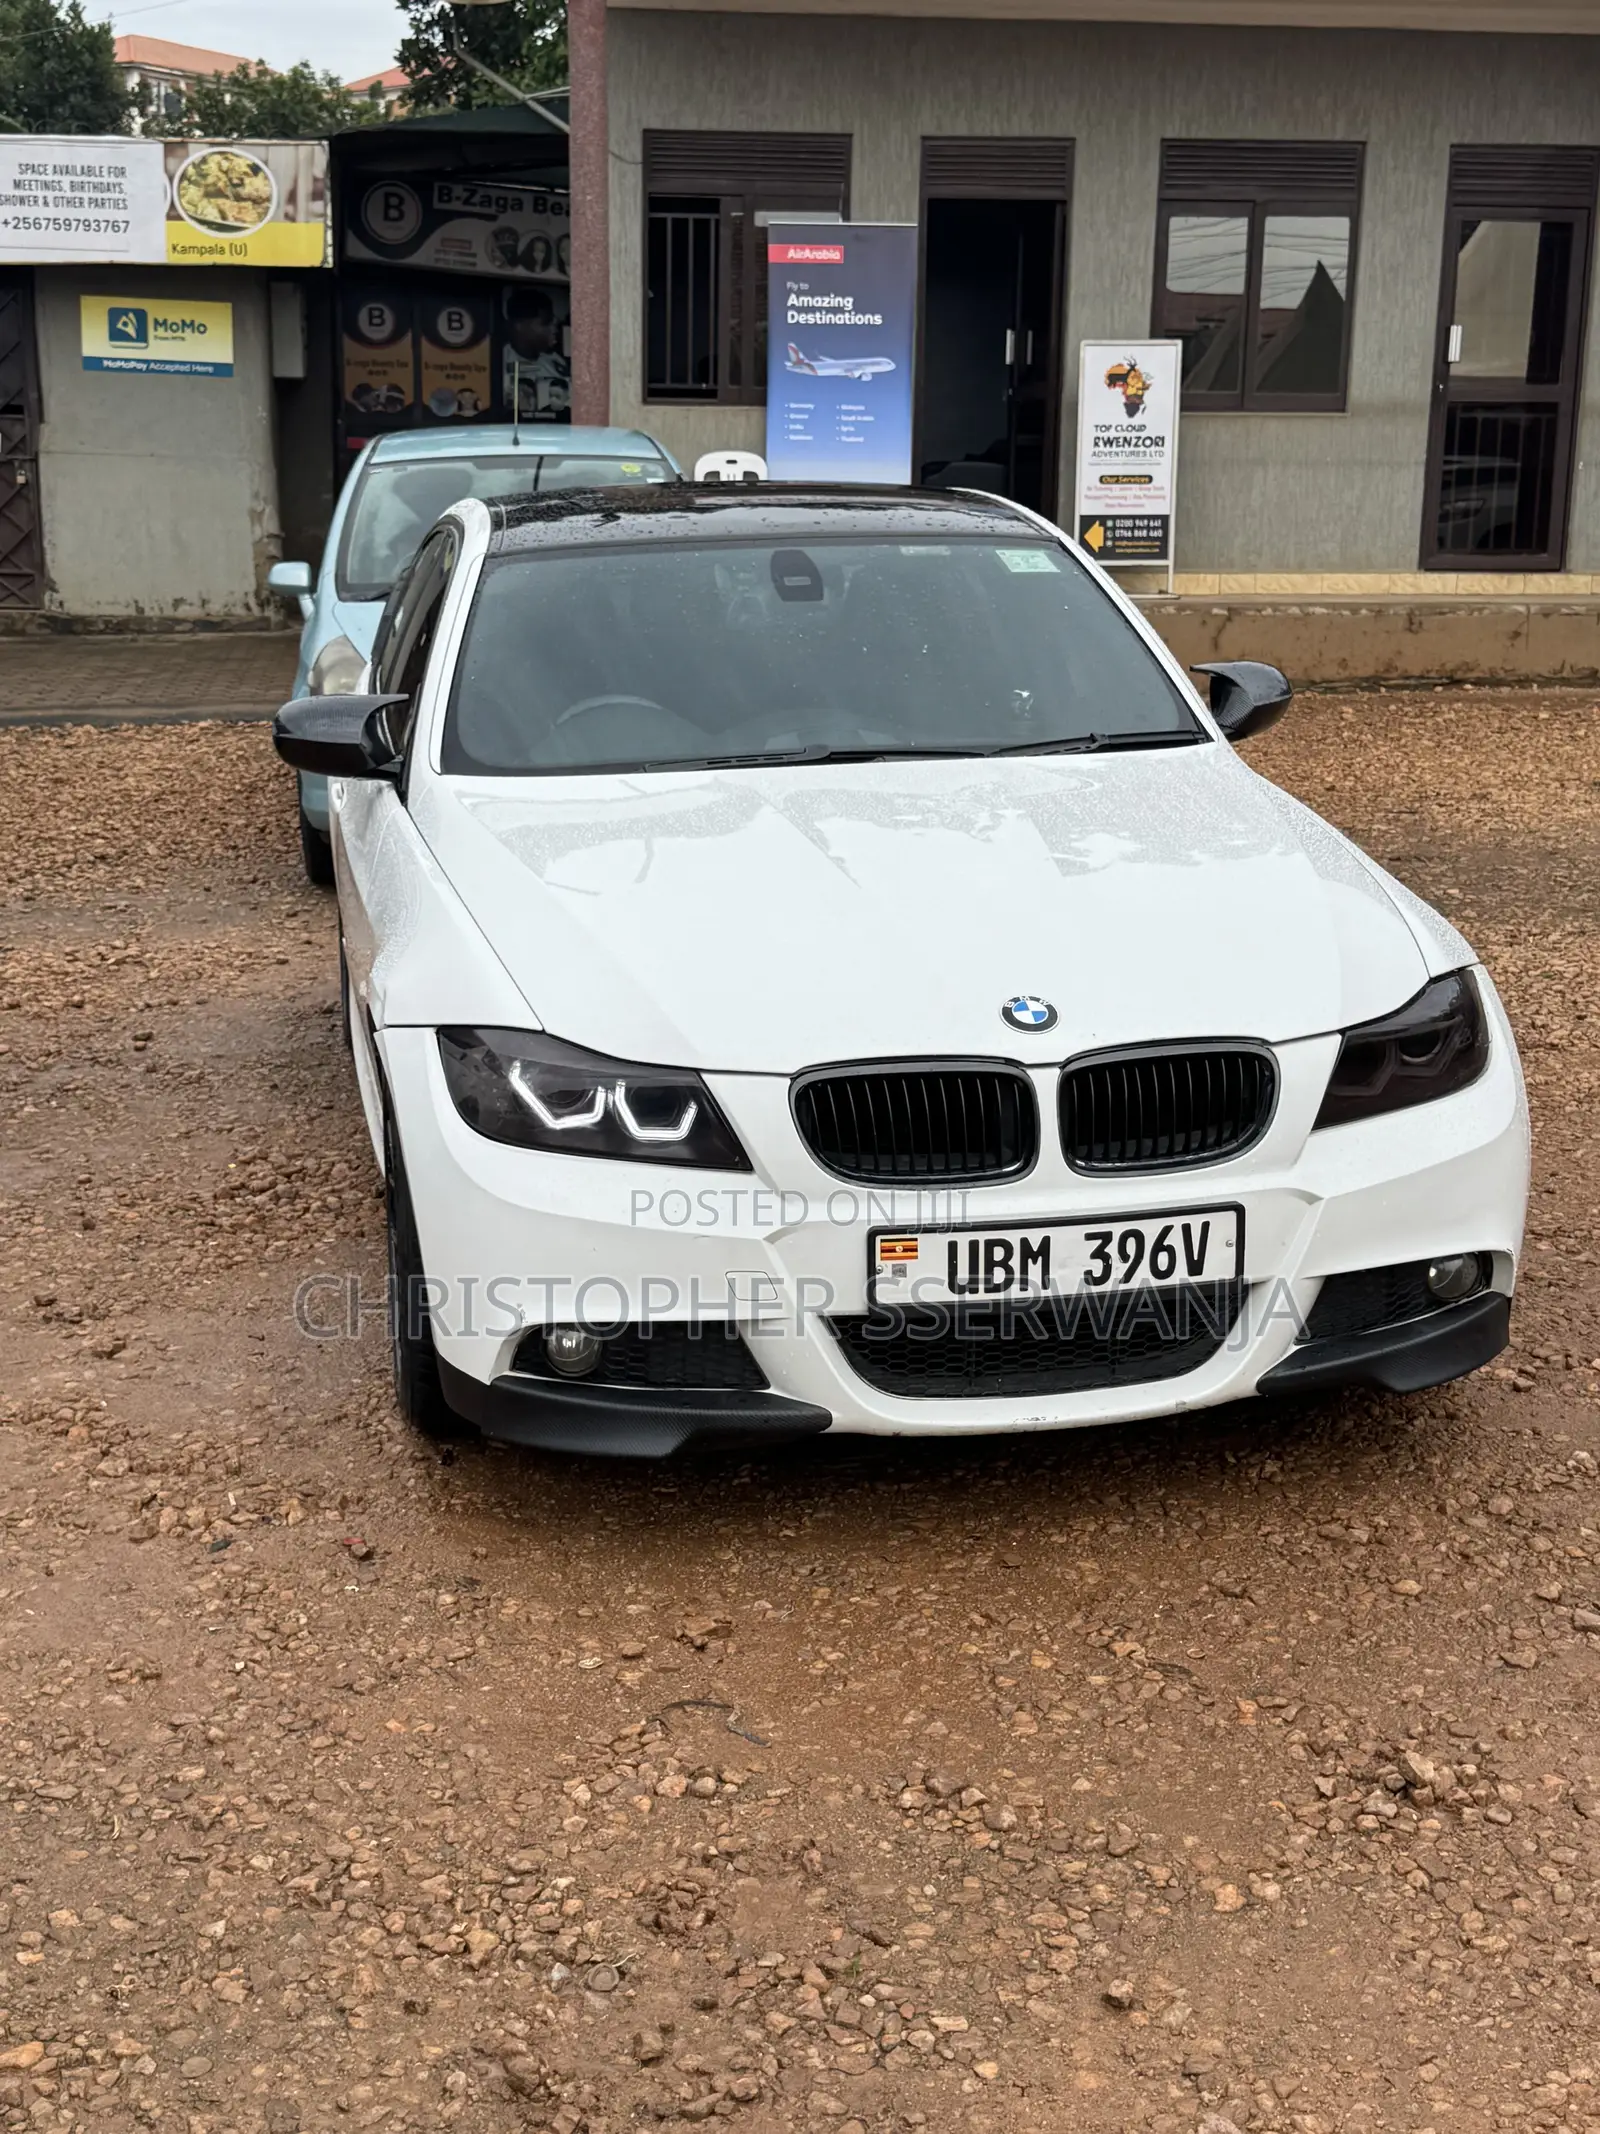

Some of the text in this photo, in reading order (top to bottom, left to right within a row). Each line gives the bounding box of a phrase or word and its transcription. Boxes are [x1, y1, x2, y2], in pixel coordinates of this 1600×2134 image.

[18, 163, 127, 178] SPACE AVAILABLE FOR
[13, 179, 67, 193] MEETINGS,
[42, 195, 50, 207] &
[53, 196, 85, 209] OTHER
[88, 197, 129, 210] PARTIES
[382, 191, 406, 223] B
[437, 185, 523, 214] B-Zaga
[2, 216, 130, 233] +256759793767
[171, 242, 248, 257] Kampala (U)
[786, 281, 810, 291] Fly to
[786, 293, 854, 311] Amazing
[367, 306, 387, 328] B
[446, 311, 466, 332] B
[786, 309, 883, 325] Destinations
[153, 318, 208, 335] MoMo
[102, 359, 147, 371] MoMoPay
[149, 361, 191, 372] Accepted
[1094, 423, 1147, 433] TOP CLOUD
[1093, 435, 1165, 448] RWENZORI
[1091, 450, 1165, 458] ADVENTURES LTD
[947, 1220, 1211, 1295] UBM 396V
